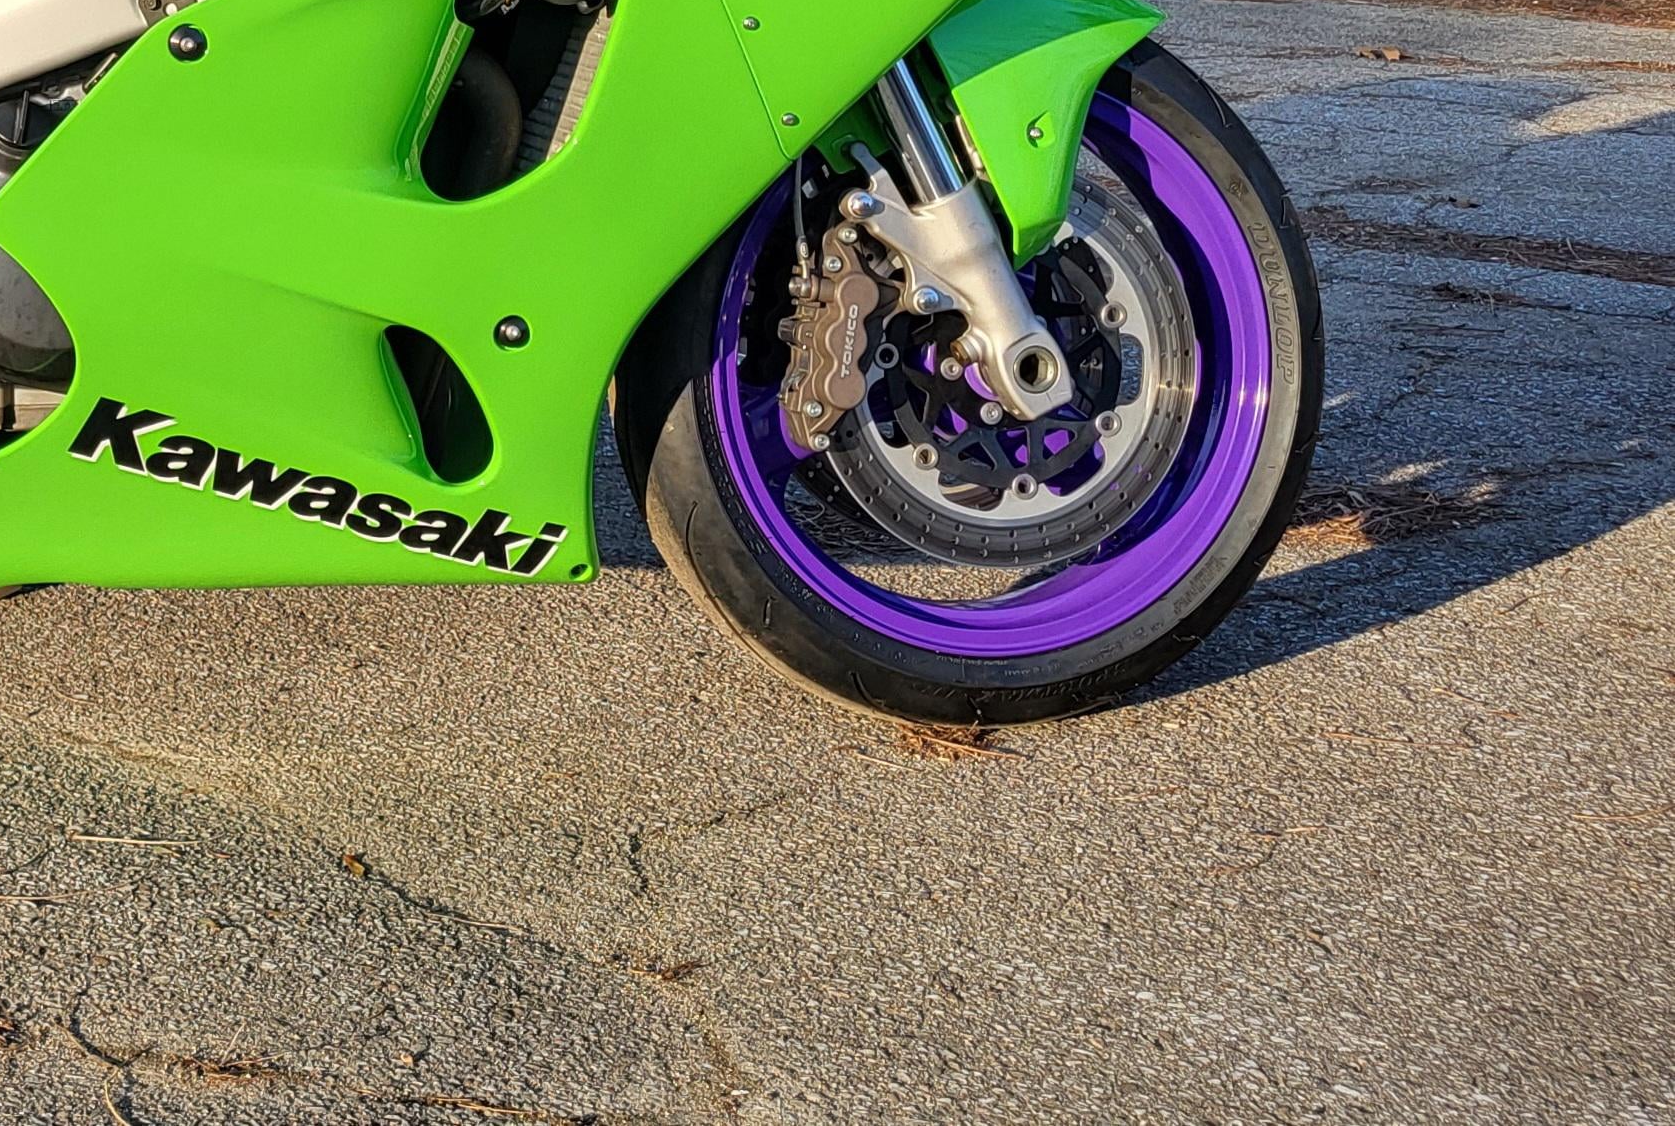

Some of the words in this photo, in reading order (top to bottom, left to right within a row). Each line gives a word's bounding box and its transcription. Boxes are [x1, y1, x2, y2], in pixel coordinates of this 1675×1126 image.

[840, 304, 859, 378] TOKICO
[1247, 222, 1295, 385] DUNLOP
[67, 396, 567, 576] Kawasaki
